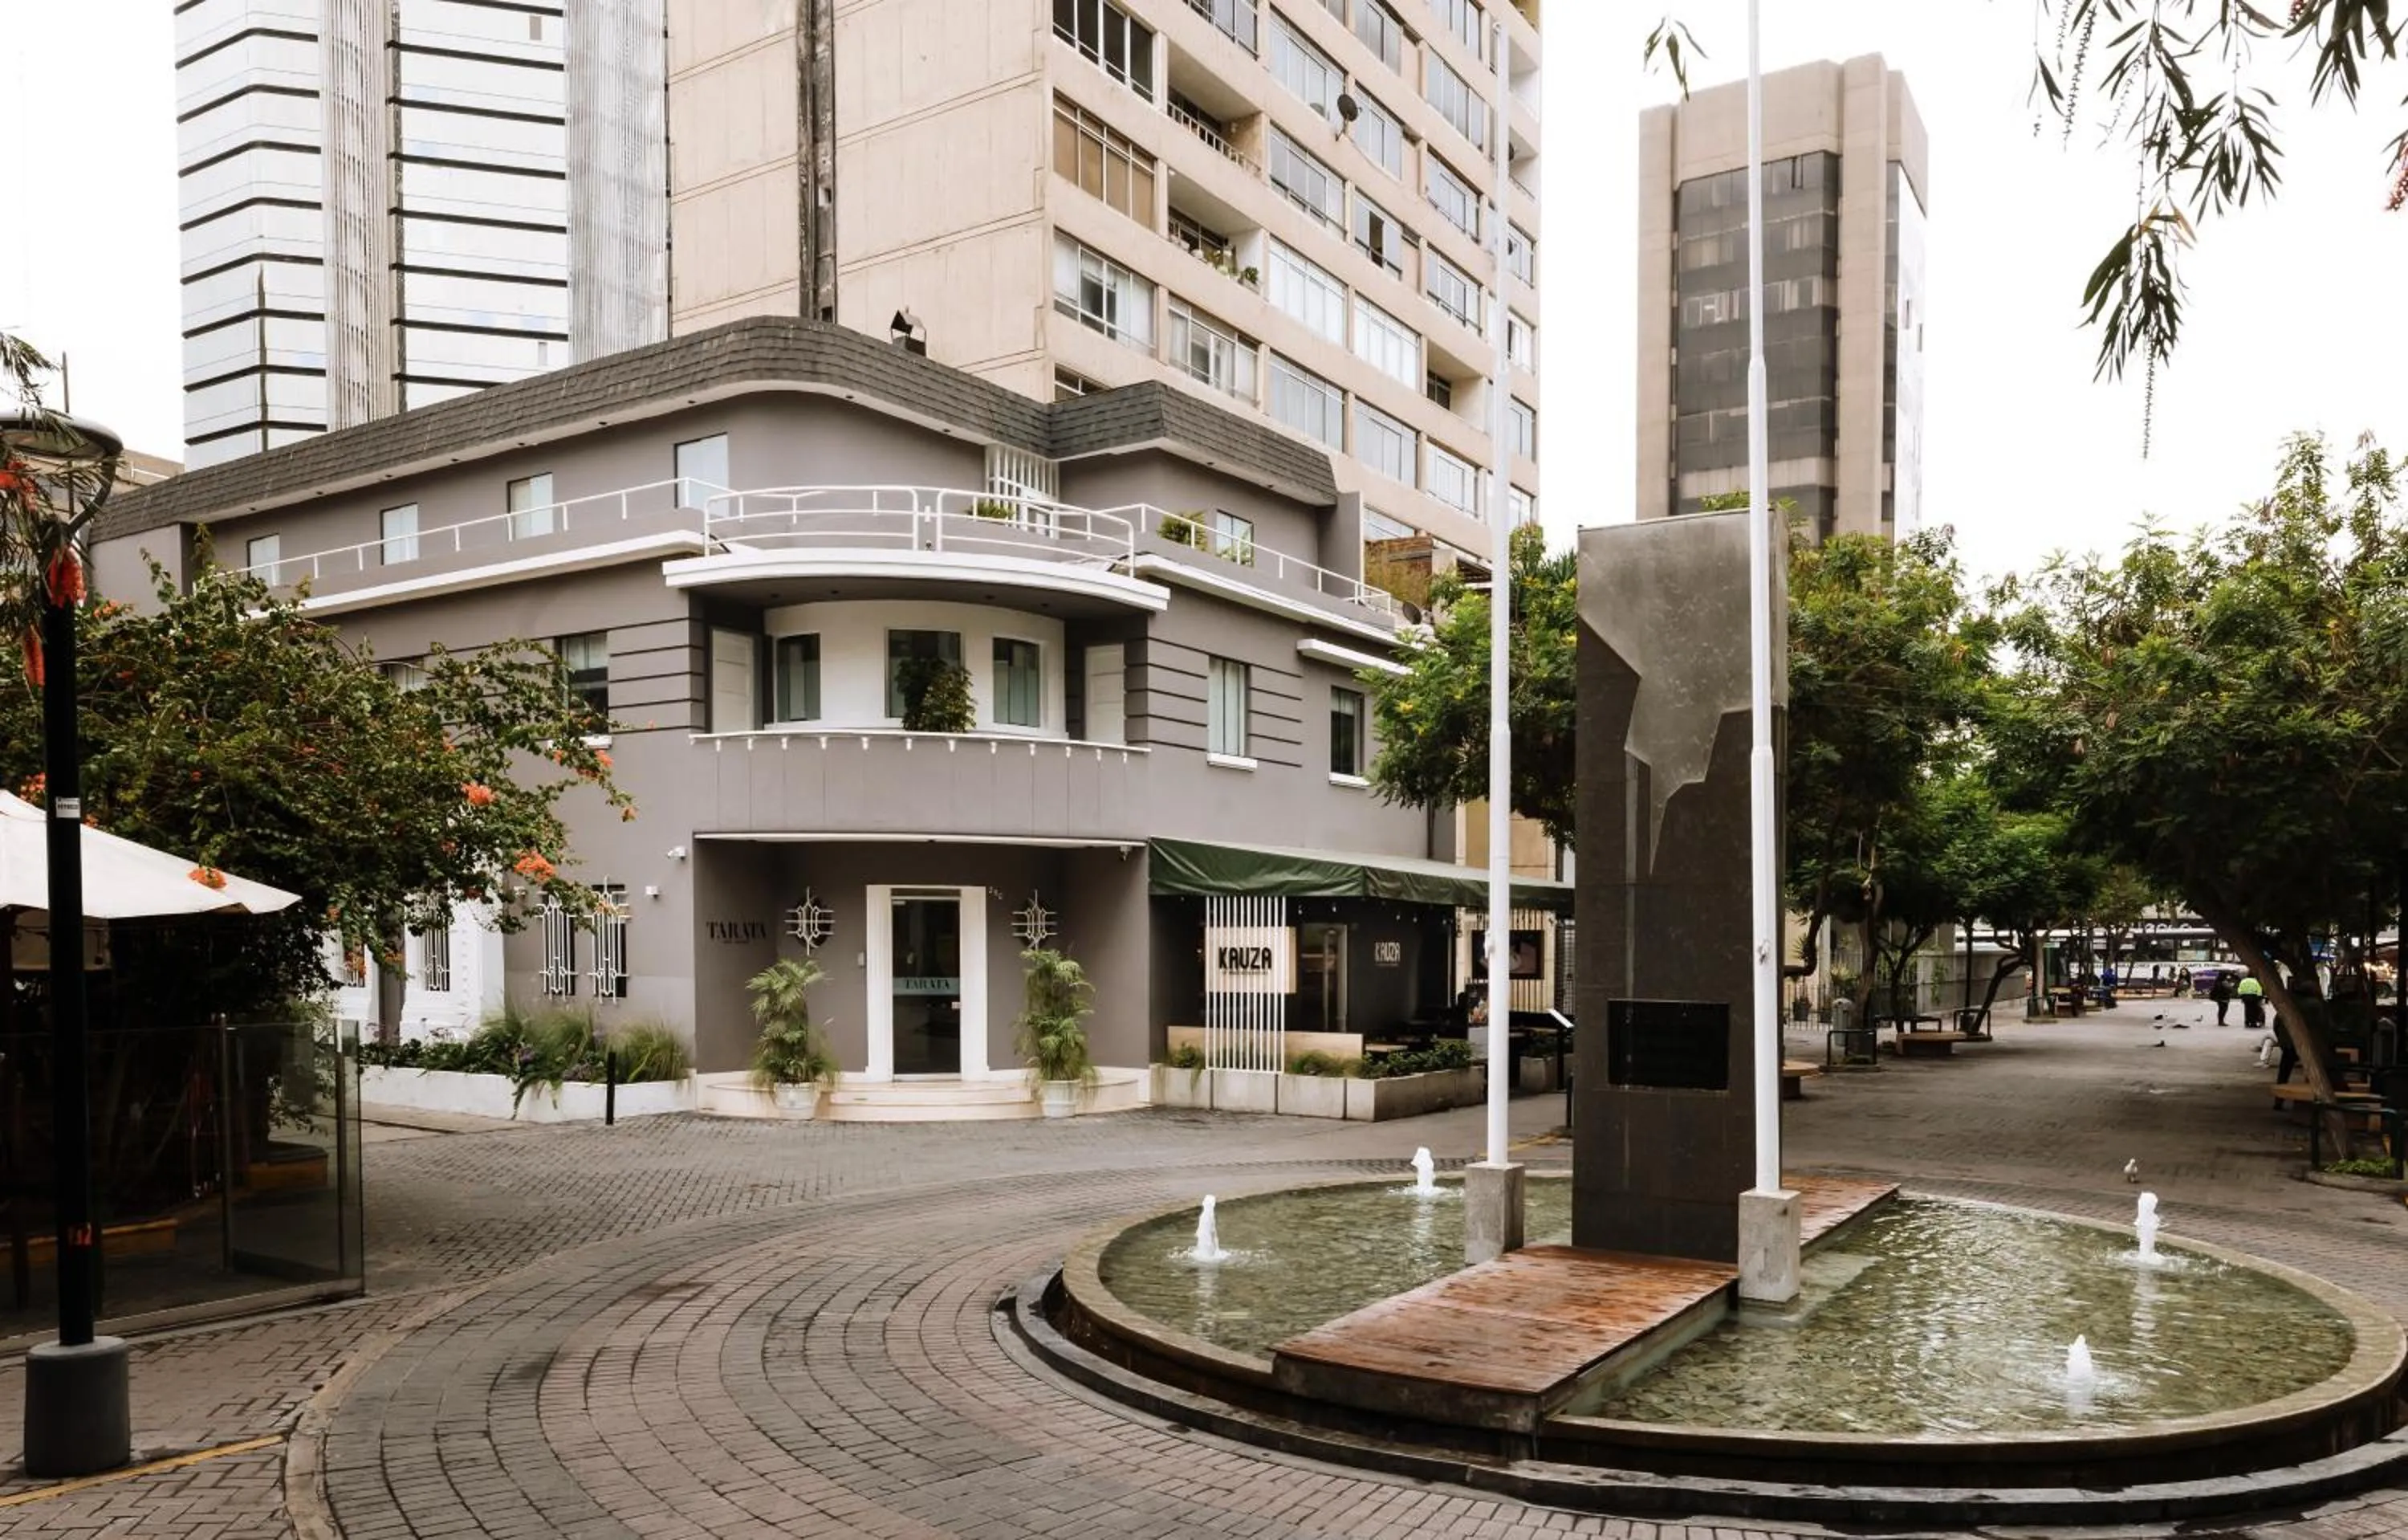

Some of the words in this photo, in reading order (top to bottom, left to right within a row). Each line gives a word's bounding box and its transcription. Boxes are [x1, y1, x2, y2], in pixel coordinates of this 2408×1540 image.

[706, 921, 767, 939] TARATA
[1218, 947, 1271, 970] KAUZA
[1375, 942, 1401, 962] KAUZA
[905, 979, 950, 989] TARATA
